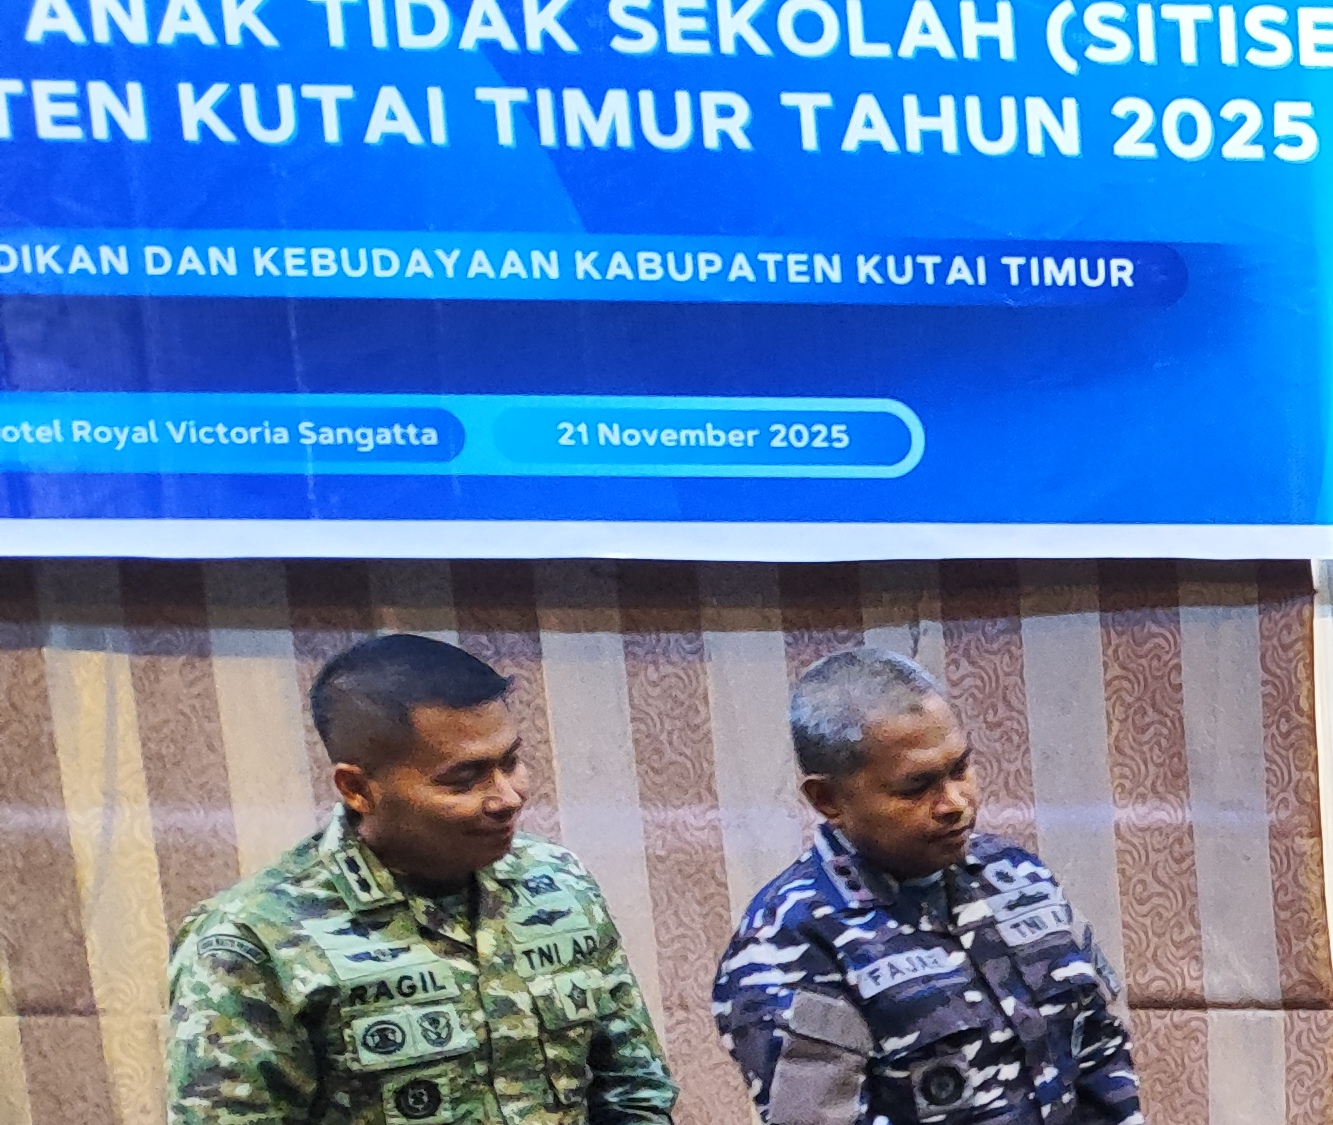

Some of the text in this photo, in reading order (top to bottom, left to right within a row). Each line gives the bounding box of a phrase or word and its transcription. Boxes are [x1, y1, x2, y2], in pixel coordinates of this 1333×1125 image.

[25, 0, 280, 47] ANAK
[306, 0, 579, 53] TIDAK
[608, 0, 1016, 61] SEKOLAH
[177, 82, 448, 146] KUTAI
[475, 87, 753, 151] TIMUR
[780, 92, 1081, 157] TAHUN
[1111, 96, 1321, 163] 2025
[143, 245, 237, 277] DAN
[252, 246, 561, 280] KEBUDAYAAN
[574, 250, 843, 284] KABUPATEN
[856, 254, 988, 287] KUTAI
[1000, 256, 1135, 289] TIMUR
[71, 419, 159, 451] Royal
[165, 420, 290, 446] Victoria
[298, 421, 439, 453] Sangatta
[557, 421, 850, 450] 21 November 2025
[347, 970, 447, 1007] RAGIL
